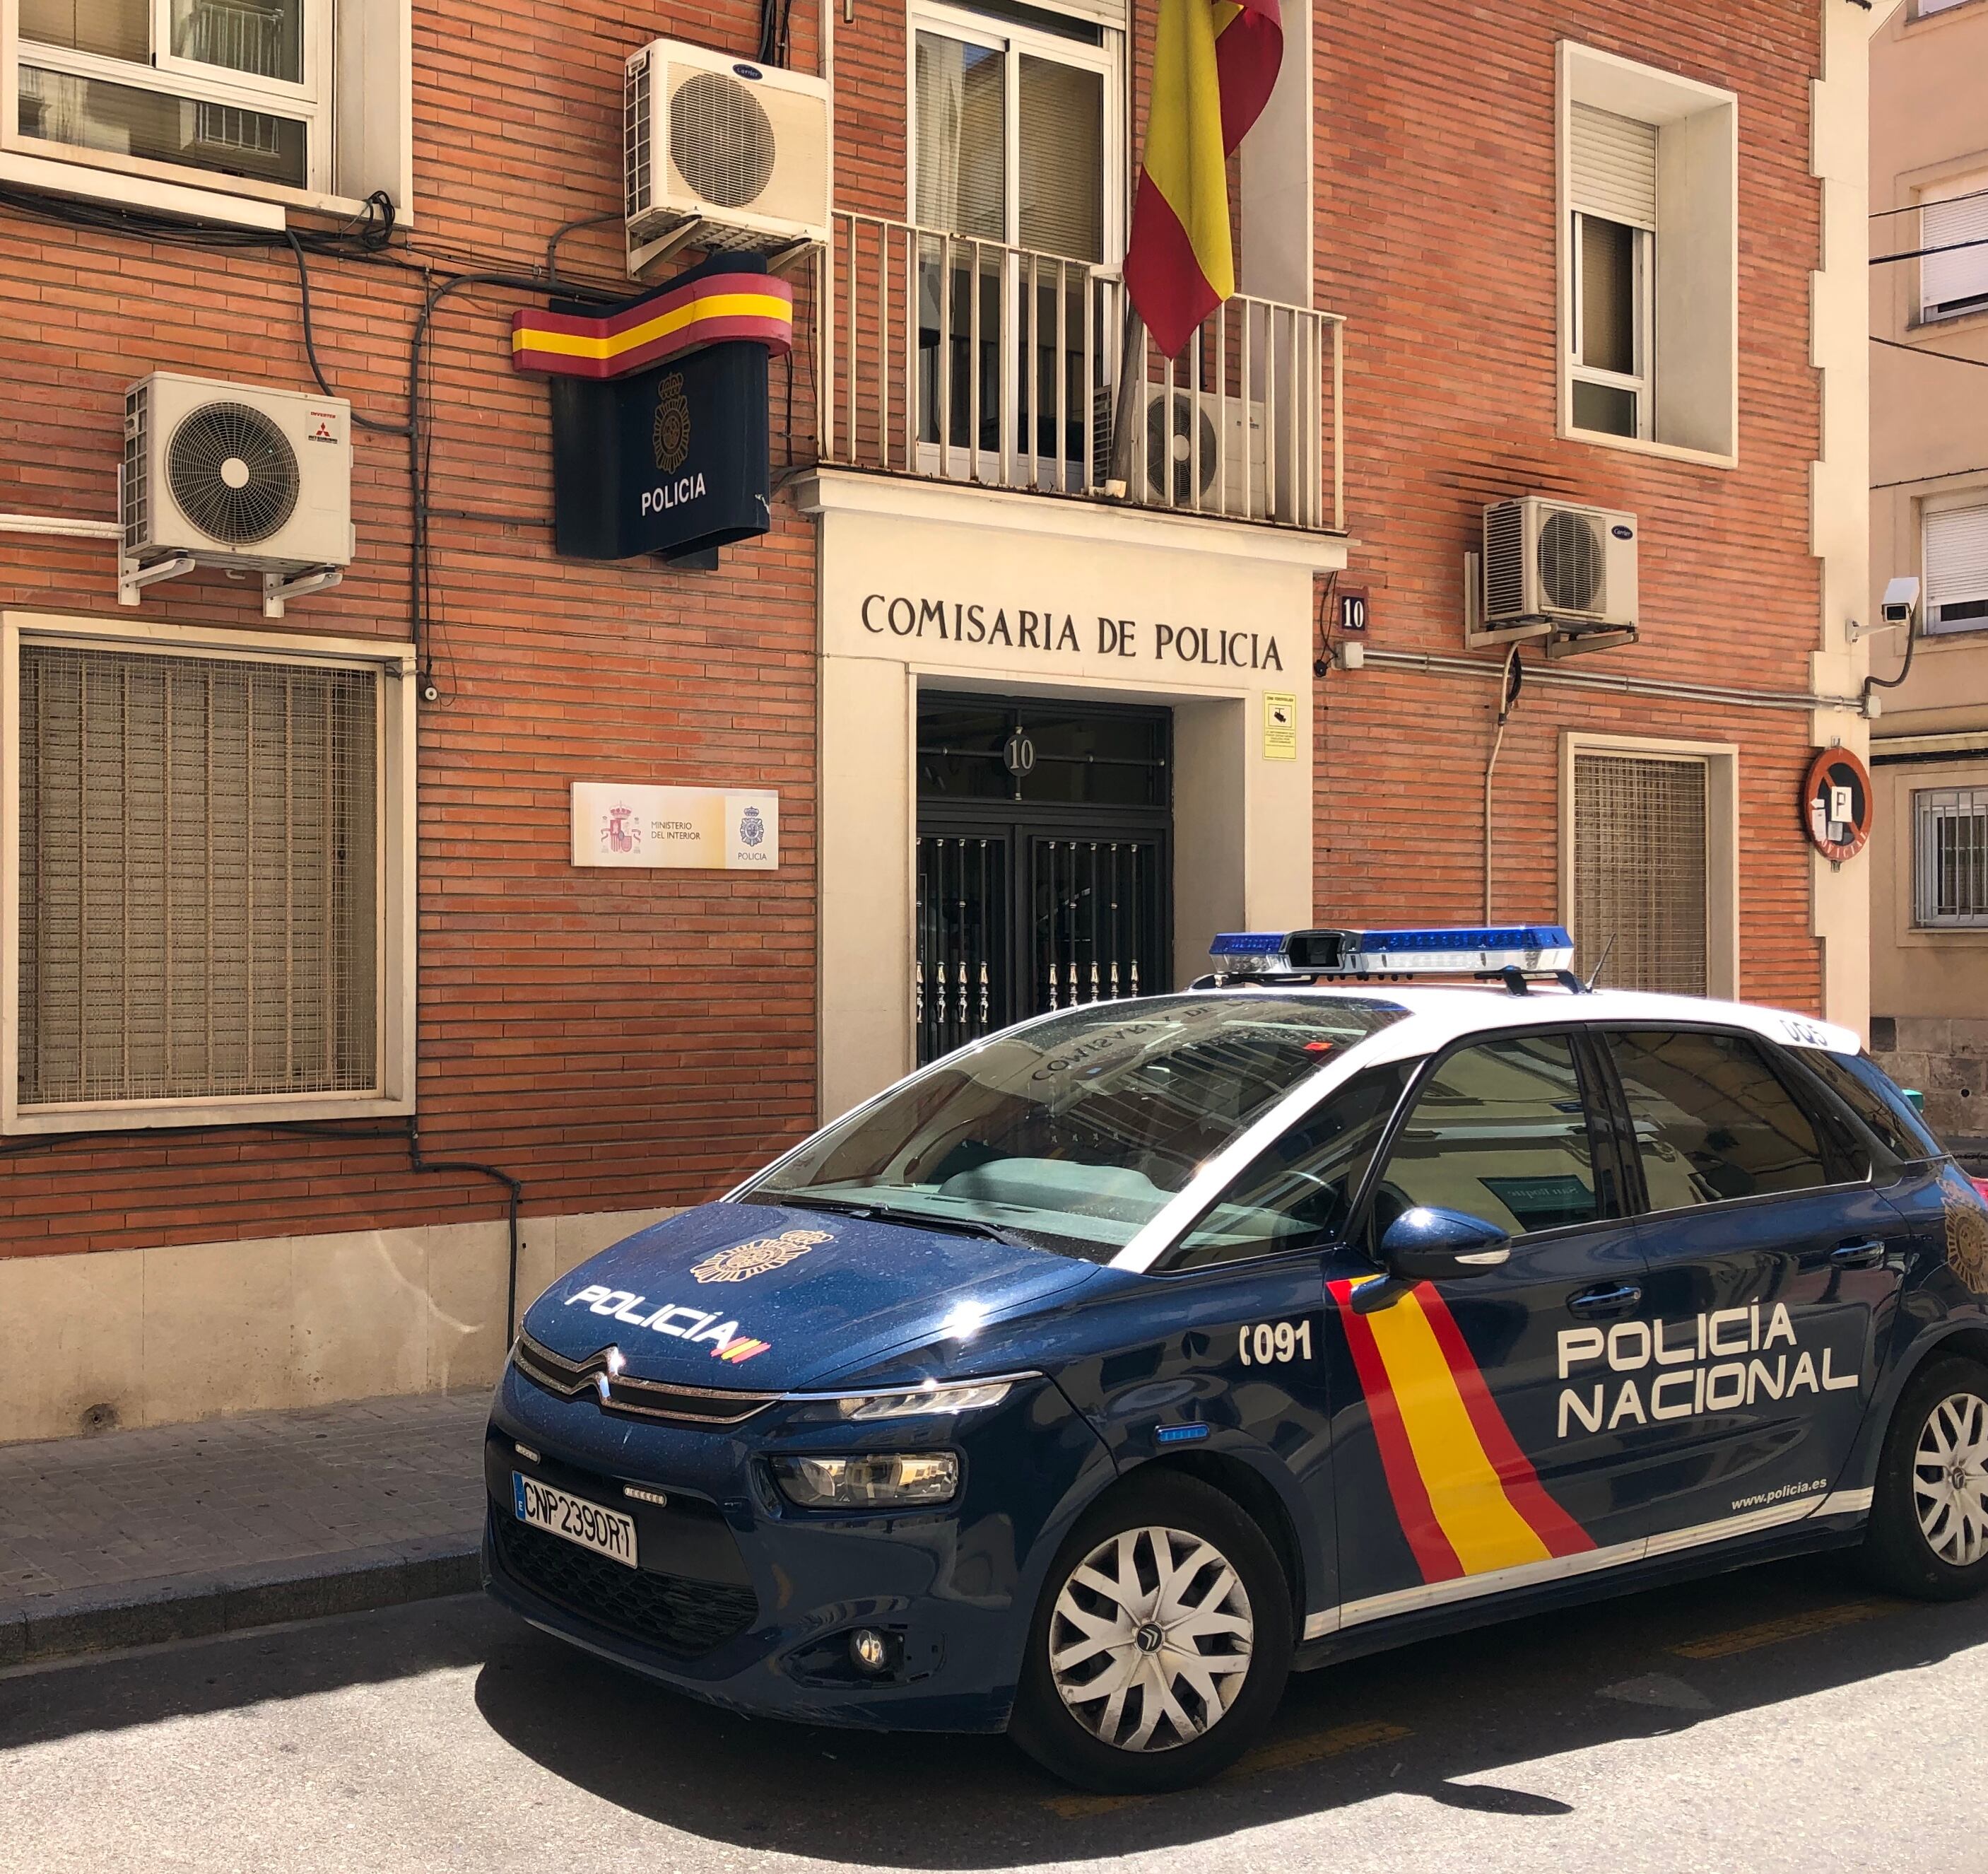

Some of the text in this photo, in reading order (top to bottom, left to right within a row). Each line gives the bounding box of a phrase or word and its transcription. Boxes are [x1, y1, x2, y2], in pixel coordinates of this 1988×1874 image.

[736, 67, 759, 77] Carrier
[642, 472, 706, 517] POLICIA
[1613, 528, 1631, 537] Carrier
[1343, 599, 1364, 628] 10
[861, 594, 1283, 671] COMISARIA DE POLICIA
[1010, 739, 1034, 770] 10
[651, 821, 693, 831] MINISTERIO
[651, 831, 701, 841] DEL INTERIOR
[738, 853, 767, 861] POLICIA
[564, 1284, 739, 1350] POLICÍA
[1253, 1320, 1312, 1364] 091
[1557, 1296, 1797, 1379] POLICÍA
[1557, 1347, 1859, 1438] NACIONAL
[518, 1501, 524, 1512] E
[1731, 1478, 1828, 1510] www.policia.es
